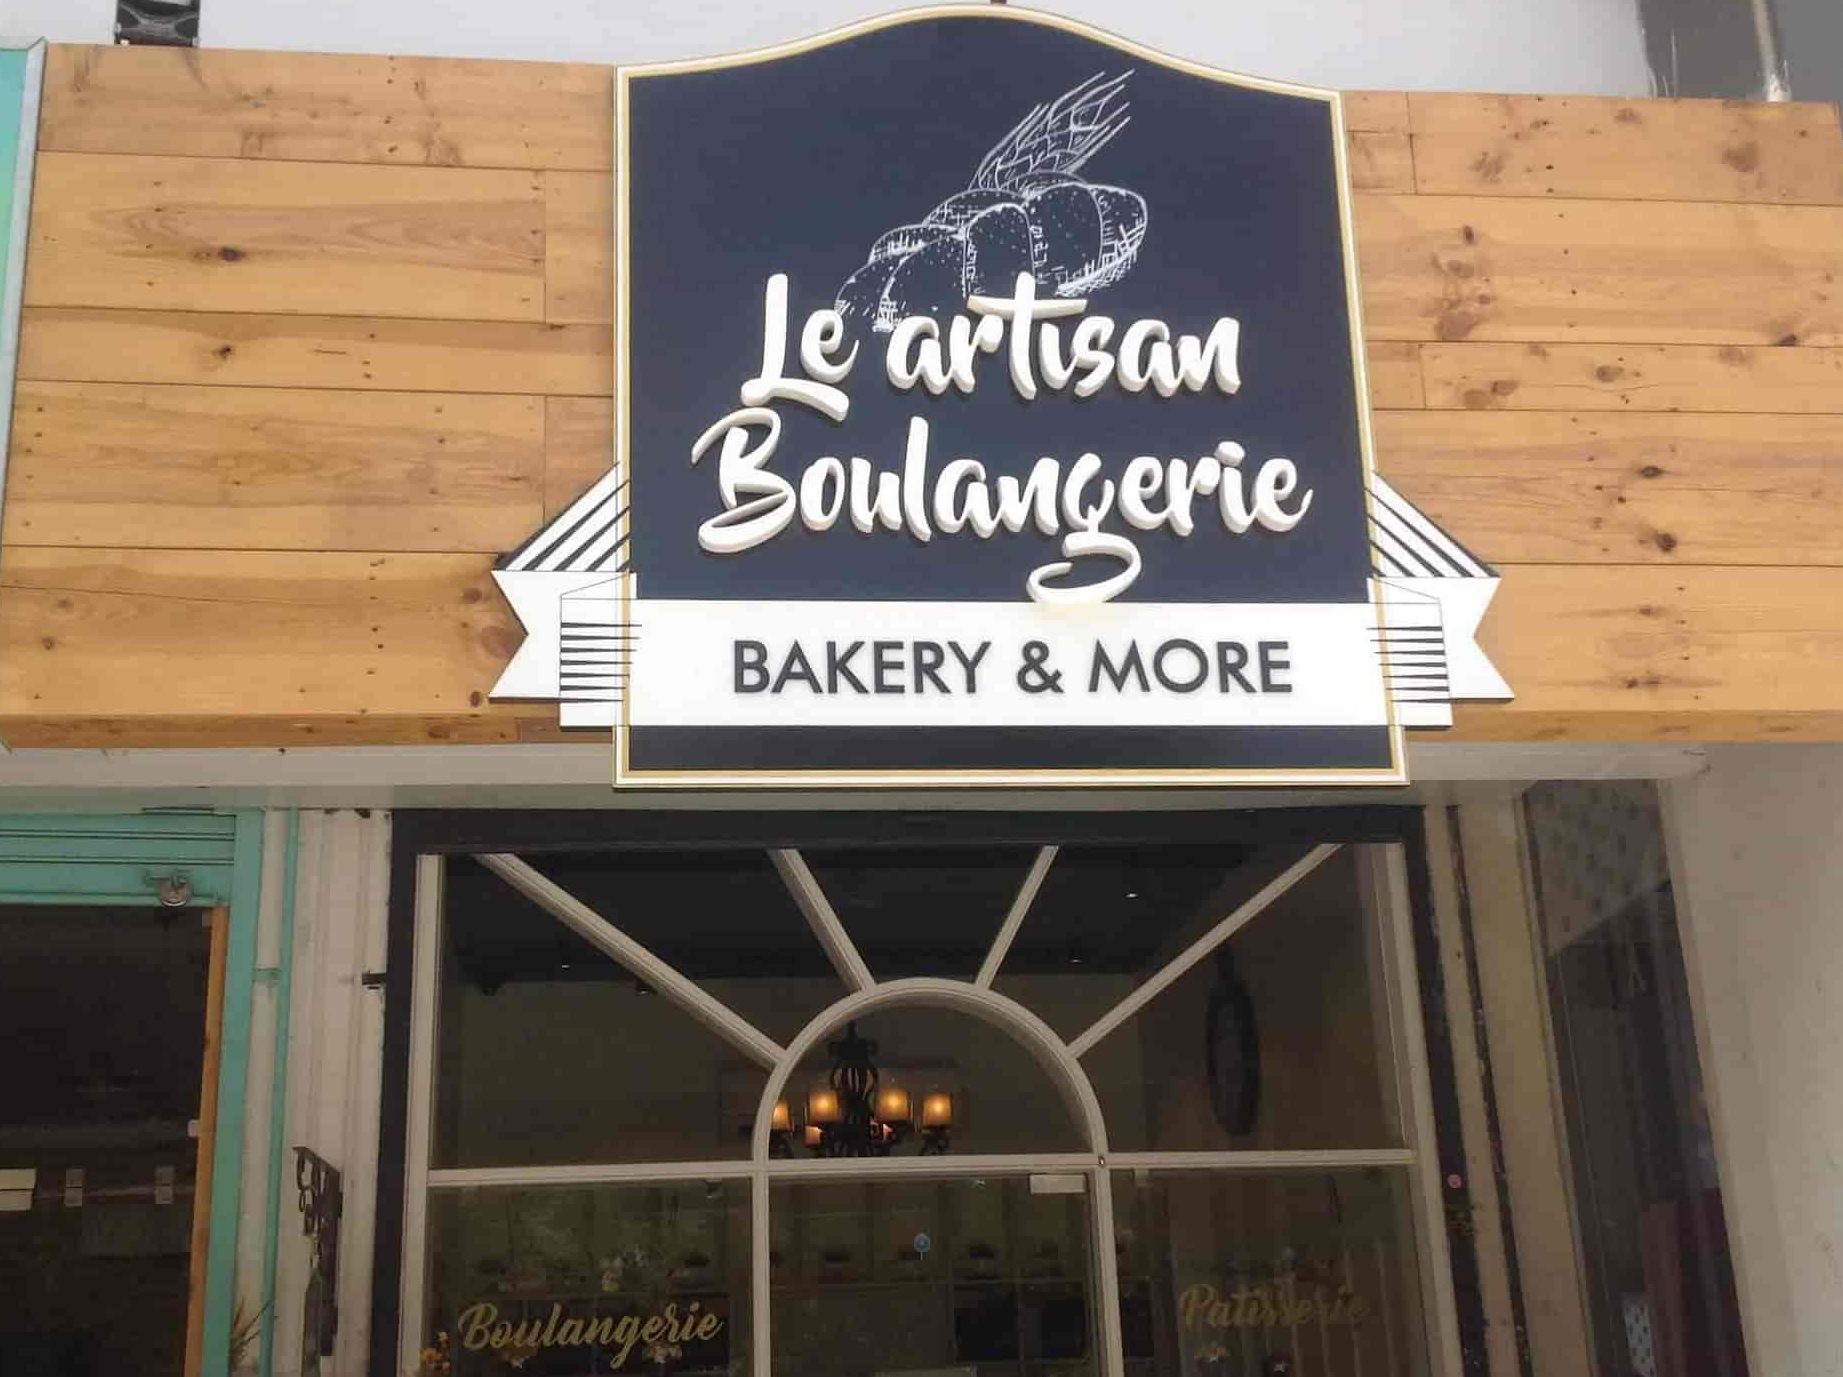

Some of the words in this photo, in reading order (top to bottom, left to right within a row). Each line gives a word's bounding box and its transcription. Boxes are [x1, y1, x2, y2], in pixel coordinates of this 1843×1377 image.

[741, 273, 859, 422] Le
[887, 272, 1240, 400] artisan
[691, 406, 1314, 604] Boulangerie
[733, 639, 992, 694] BAKERY
[1016, 639, 1064, 694] &
[1088, 638, 1293, 693] MORE
[458, 1301, 725, 1370] Boulangerie
